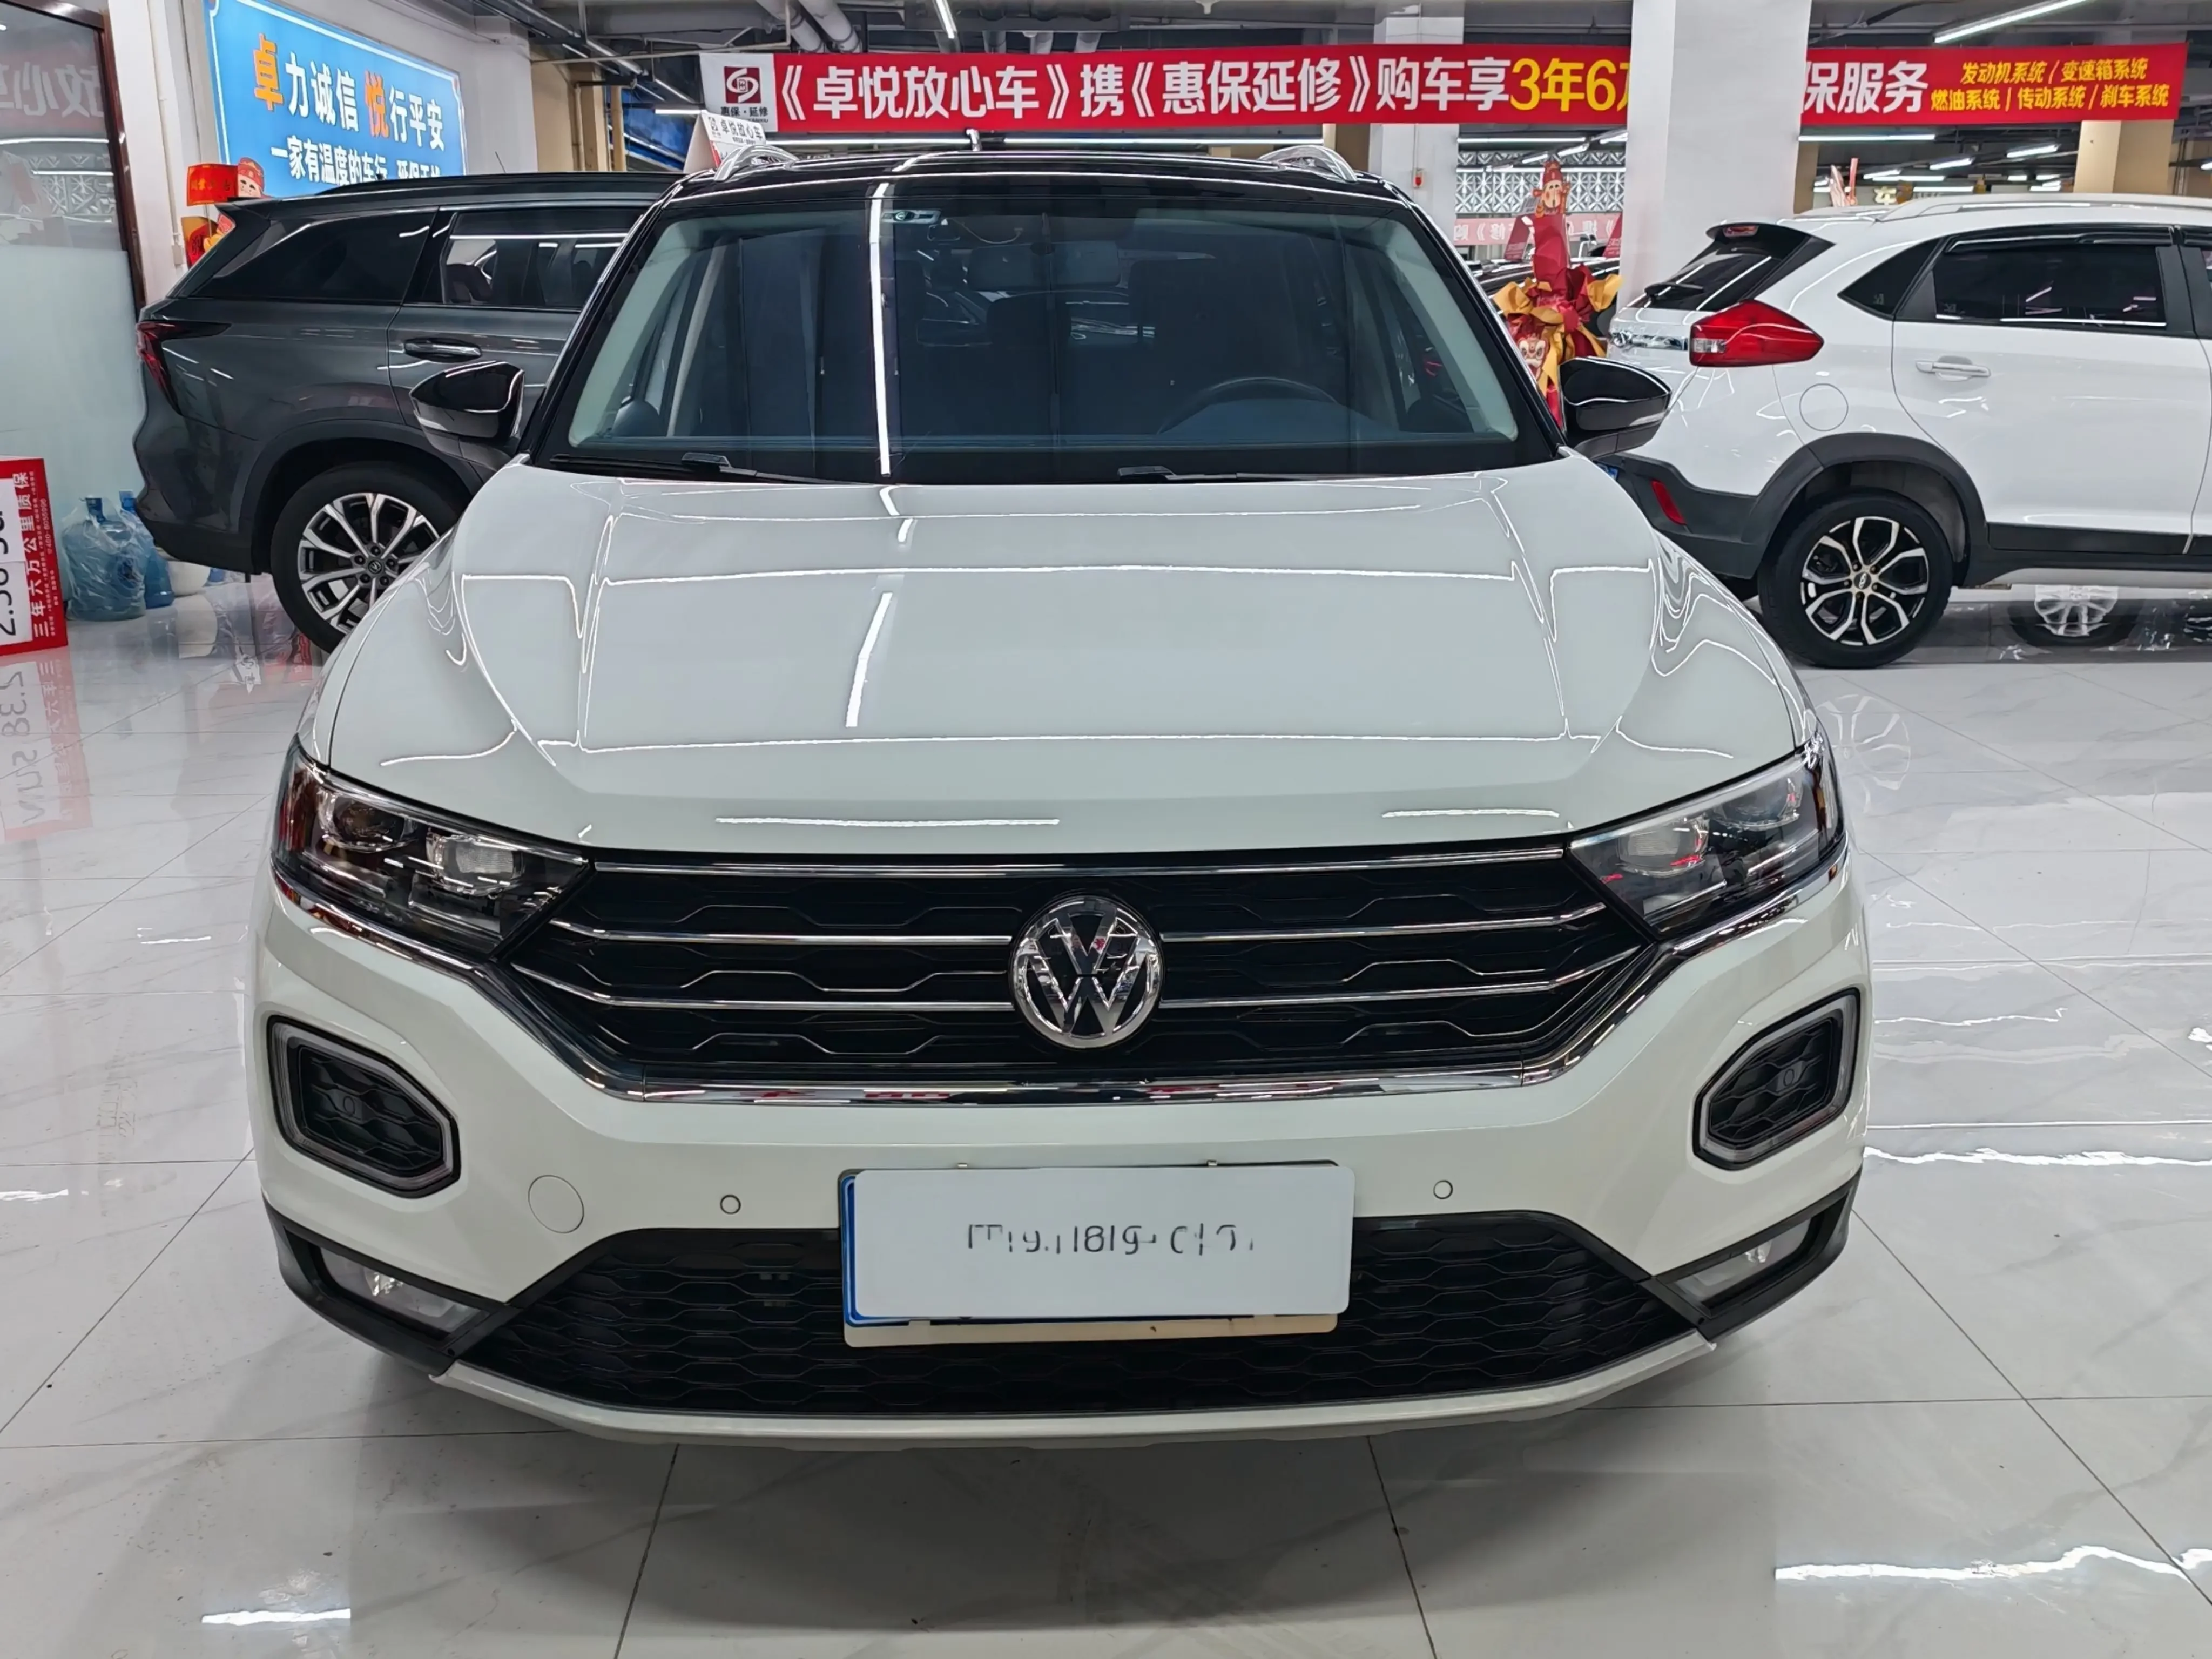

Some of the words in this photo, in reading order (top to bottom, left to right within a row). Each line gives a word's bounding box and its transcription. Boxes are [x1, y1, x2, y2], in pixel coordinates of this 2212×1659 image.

[254, 33, 359, 132] 卓力诚信
[365, 70, 444, 151] 悦行平安
[271, 136, 388, 186] 一家有温度的车行
